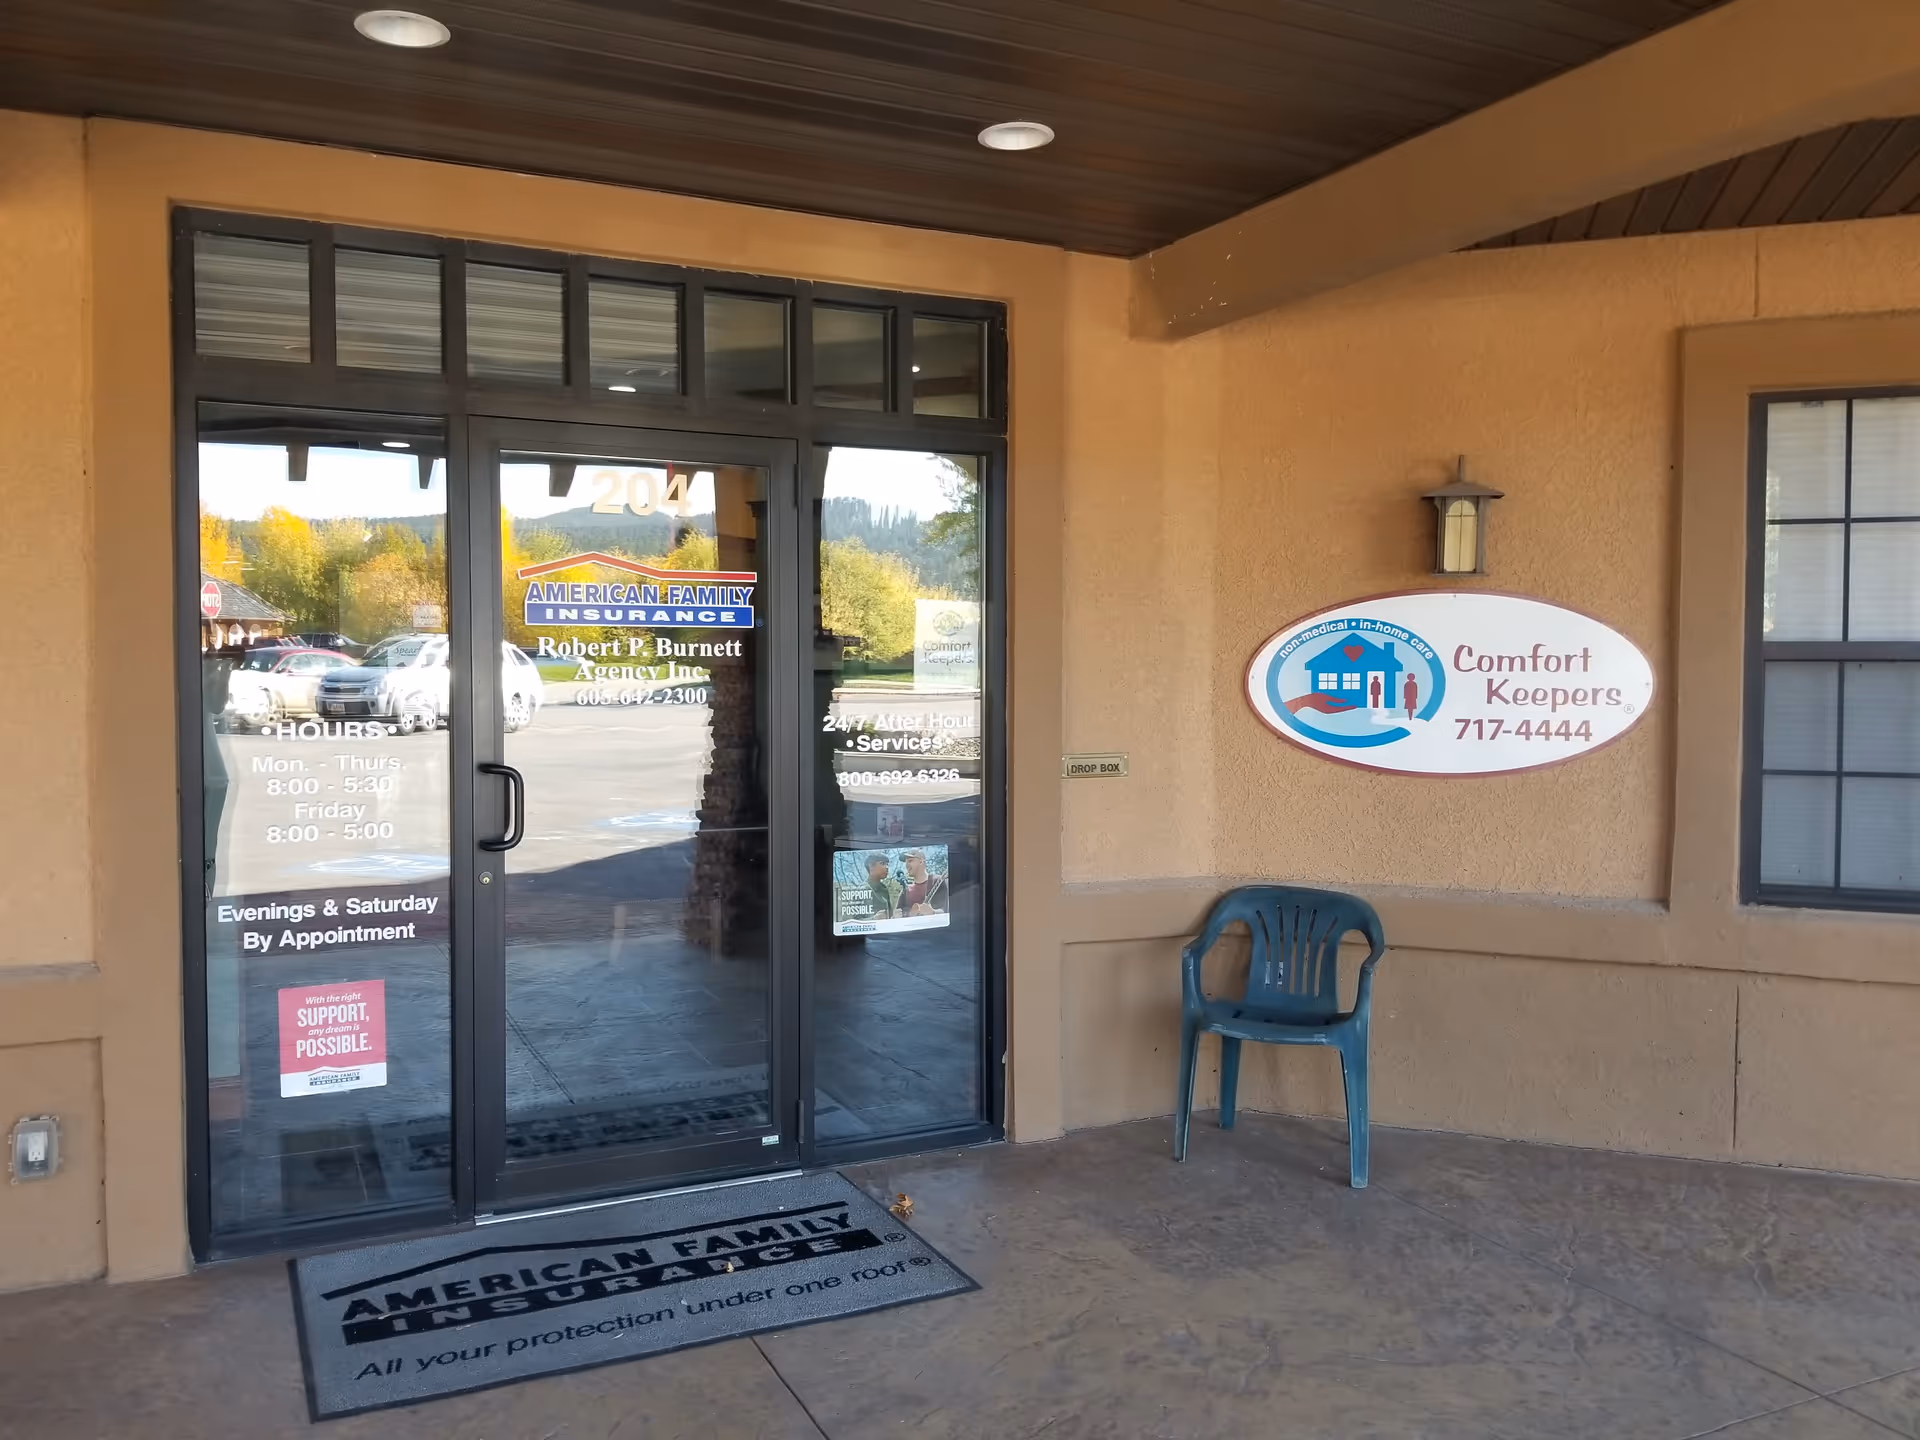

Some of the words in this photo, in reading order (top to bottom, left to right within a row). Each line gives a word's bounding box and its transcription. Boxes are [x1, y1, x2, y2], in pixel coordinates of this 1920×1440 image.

[592, 469, 691, 517] 204
[525, 581, 658, 604] AMERICAN
[668, 584, 754, 606] FAMILY
[545, 608, 736, 622] INSURANCE
[537, 636, 621, 657] Robert
[628, 637, 648, 657] P.
[656, 637, 742, 657] Burnett
[923, 641, 971, 651] Comfort
[1279, 619, 1348, 659] non-medical
[1359, 619, 1409, 641] in-home
[1410, 638, 1434, 660] care
[1453, 643, 1593, 673] Comfort
[574, 661, 660, 685] Agency
[669, 661, 710, 682] Inc.
[576, 687, 707, 706] 605-642-2300
[276, 721, 387, 741] HOURS
[822, 714, 867, 733] 24/7
[874, 713, 923, 731] After
[1454, 718, 1593, 742] 717-4444
[252, 756, 309, 773] Mon.
[334, 754, 407, 771] Thurs.
[1070, 764, 1097, 774] DROP
[1100, 763, 1120, 772] BOX
[266, 778, 319, 796] 8:00
[343, 776, 393, 793] 5:30
[838, 768, 960, 787] 800-692-6326
[295, 801, 366, 821] Friday
[266, 825, 319, 844] 8:00
[343, 822, 394, 841] 5:00
[217, 902, 315, 923] Evenings
[323, 899, 338, 916] &
[346, 895, 438, 914] Saturday
[243, 932, 272, 952] By
[279, 923, 415, 950] Appointment
[305, 995, 325, 1005] With
[326, 994, 340, 1003] the
[341, 992, 361, 1003] right
[297, 1002, 370, 1027] SUPPORT,
[308, 1028, 324, 1037] any
[325, 1025, 352, 1034] dream
[353, 1023, 360, 1031] is
[296, 1032, 373, 1058] POSSIBLE.
[341, 1247, 655, 1322] AMERICAN
[671, 1211, 852, 1257] FAMILY
[392, 1239, 842, 1332] INSURANCE
[354, 1358, 403, 1381] All
[416, 1343, 497, 1373] your
[508, 1308, 675, 1356] protection
[686, 1286, 776, 1315] under
[785, 1277, 842, 1297] one
